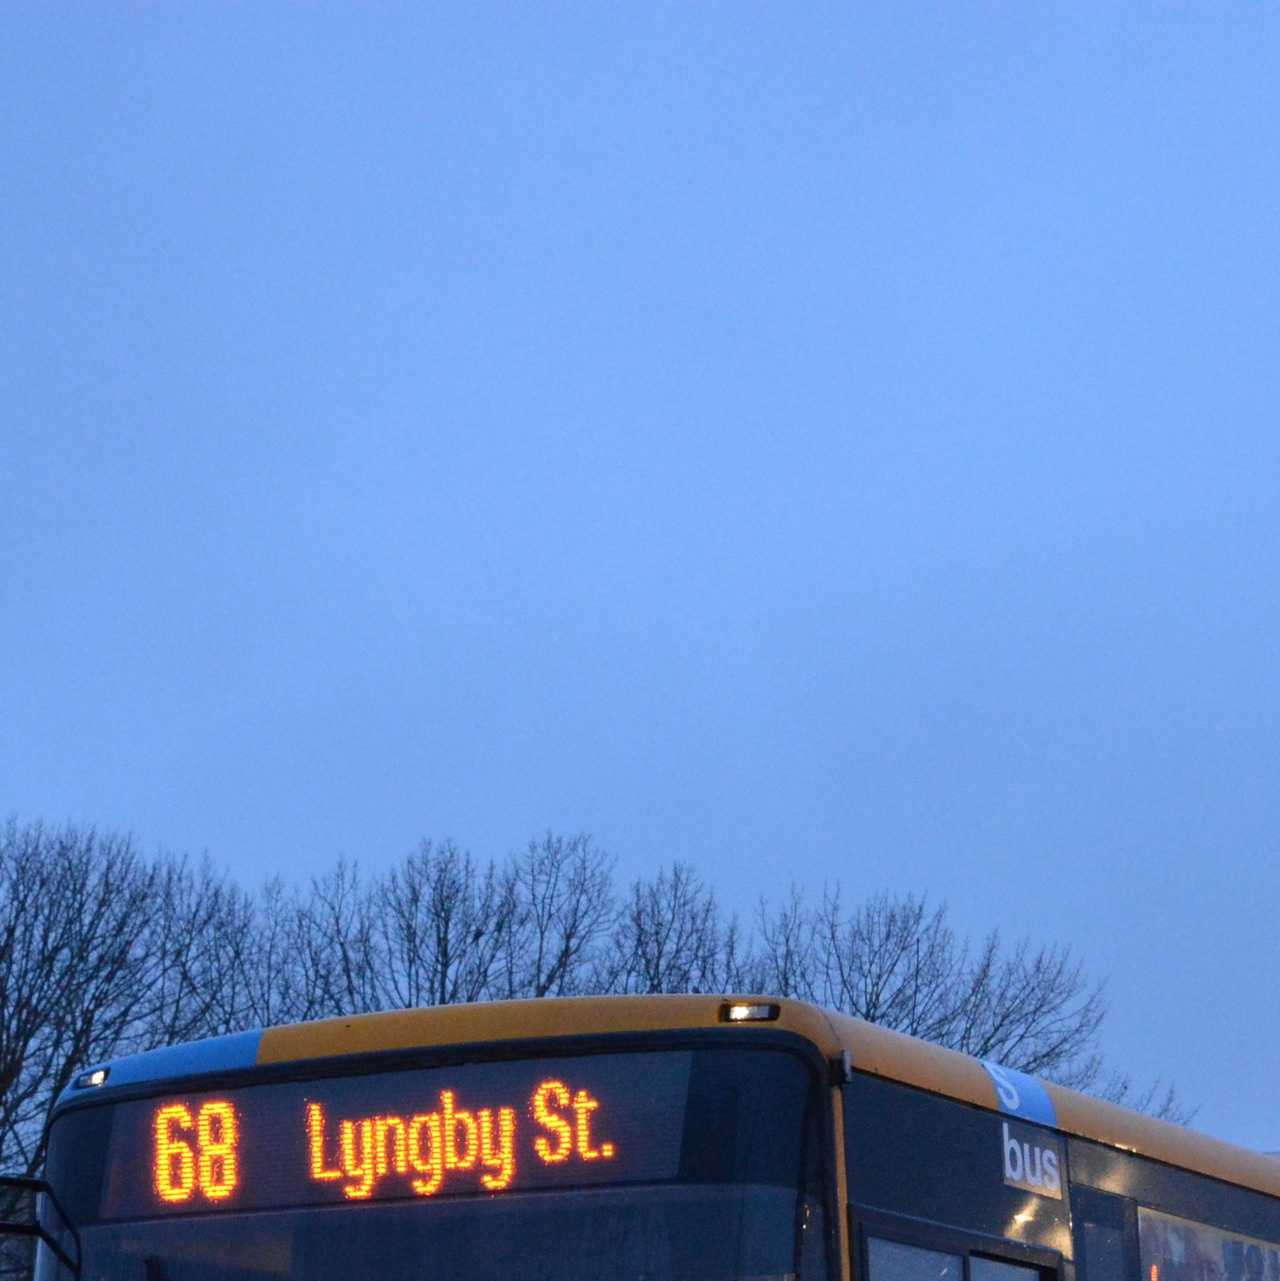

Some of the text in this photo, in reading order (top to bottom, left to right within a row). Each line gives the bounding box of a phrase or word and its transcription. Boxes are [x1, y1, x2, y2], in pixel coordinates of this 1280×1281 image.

[154, 1078, 616, 1202] 68 Lyngby St.
[1002, 1122, 1061, 1191] bus
